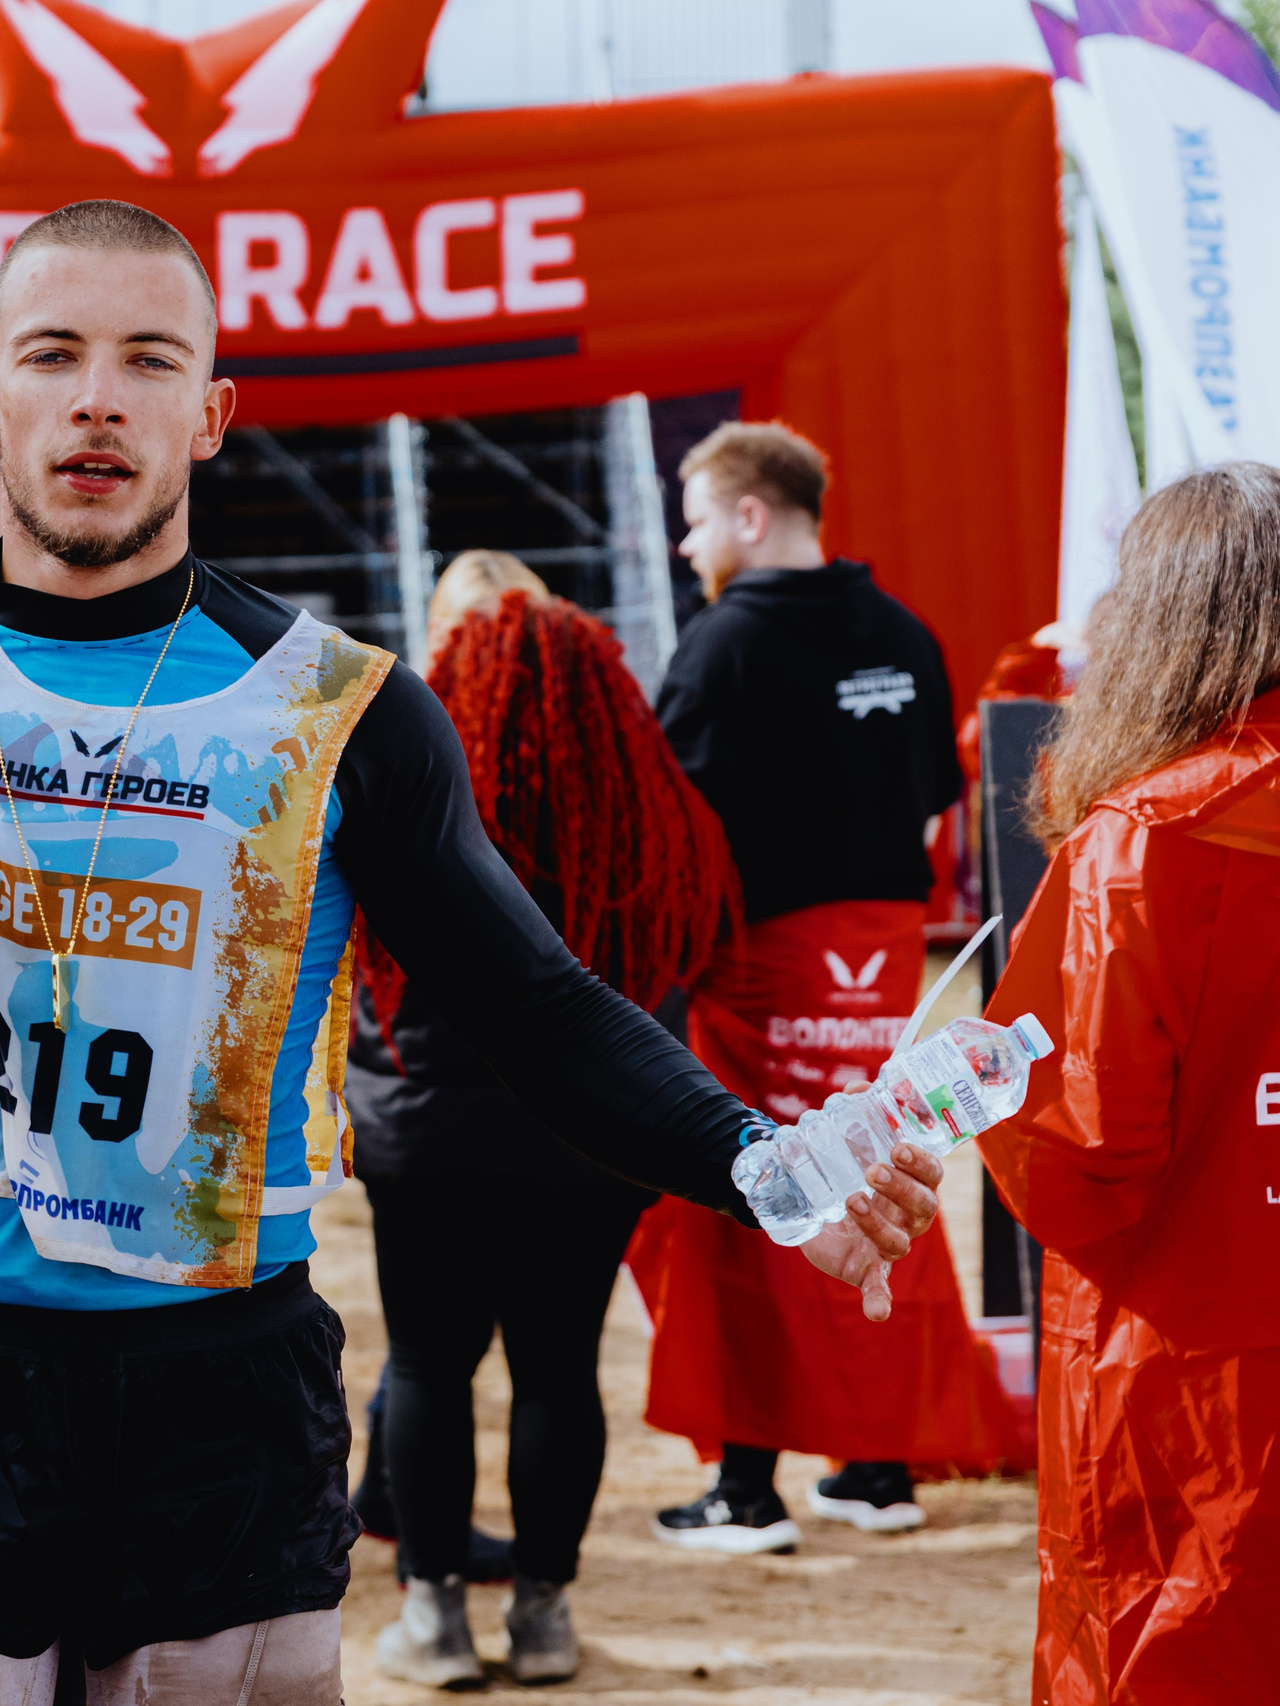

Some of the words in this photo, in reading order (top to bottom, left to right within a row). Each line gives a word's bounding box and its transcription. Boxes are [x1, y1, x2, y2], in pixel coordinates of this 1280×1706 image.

[216, 189, 587, 331] RACE
[80, 771, 210, 809] ГЕРОЕВ
[58, 888, 189, 952] 18-29
[10, 1179, 145, 1231] ПРОМБАНК
